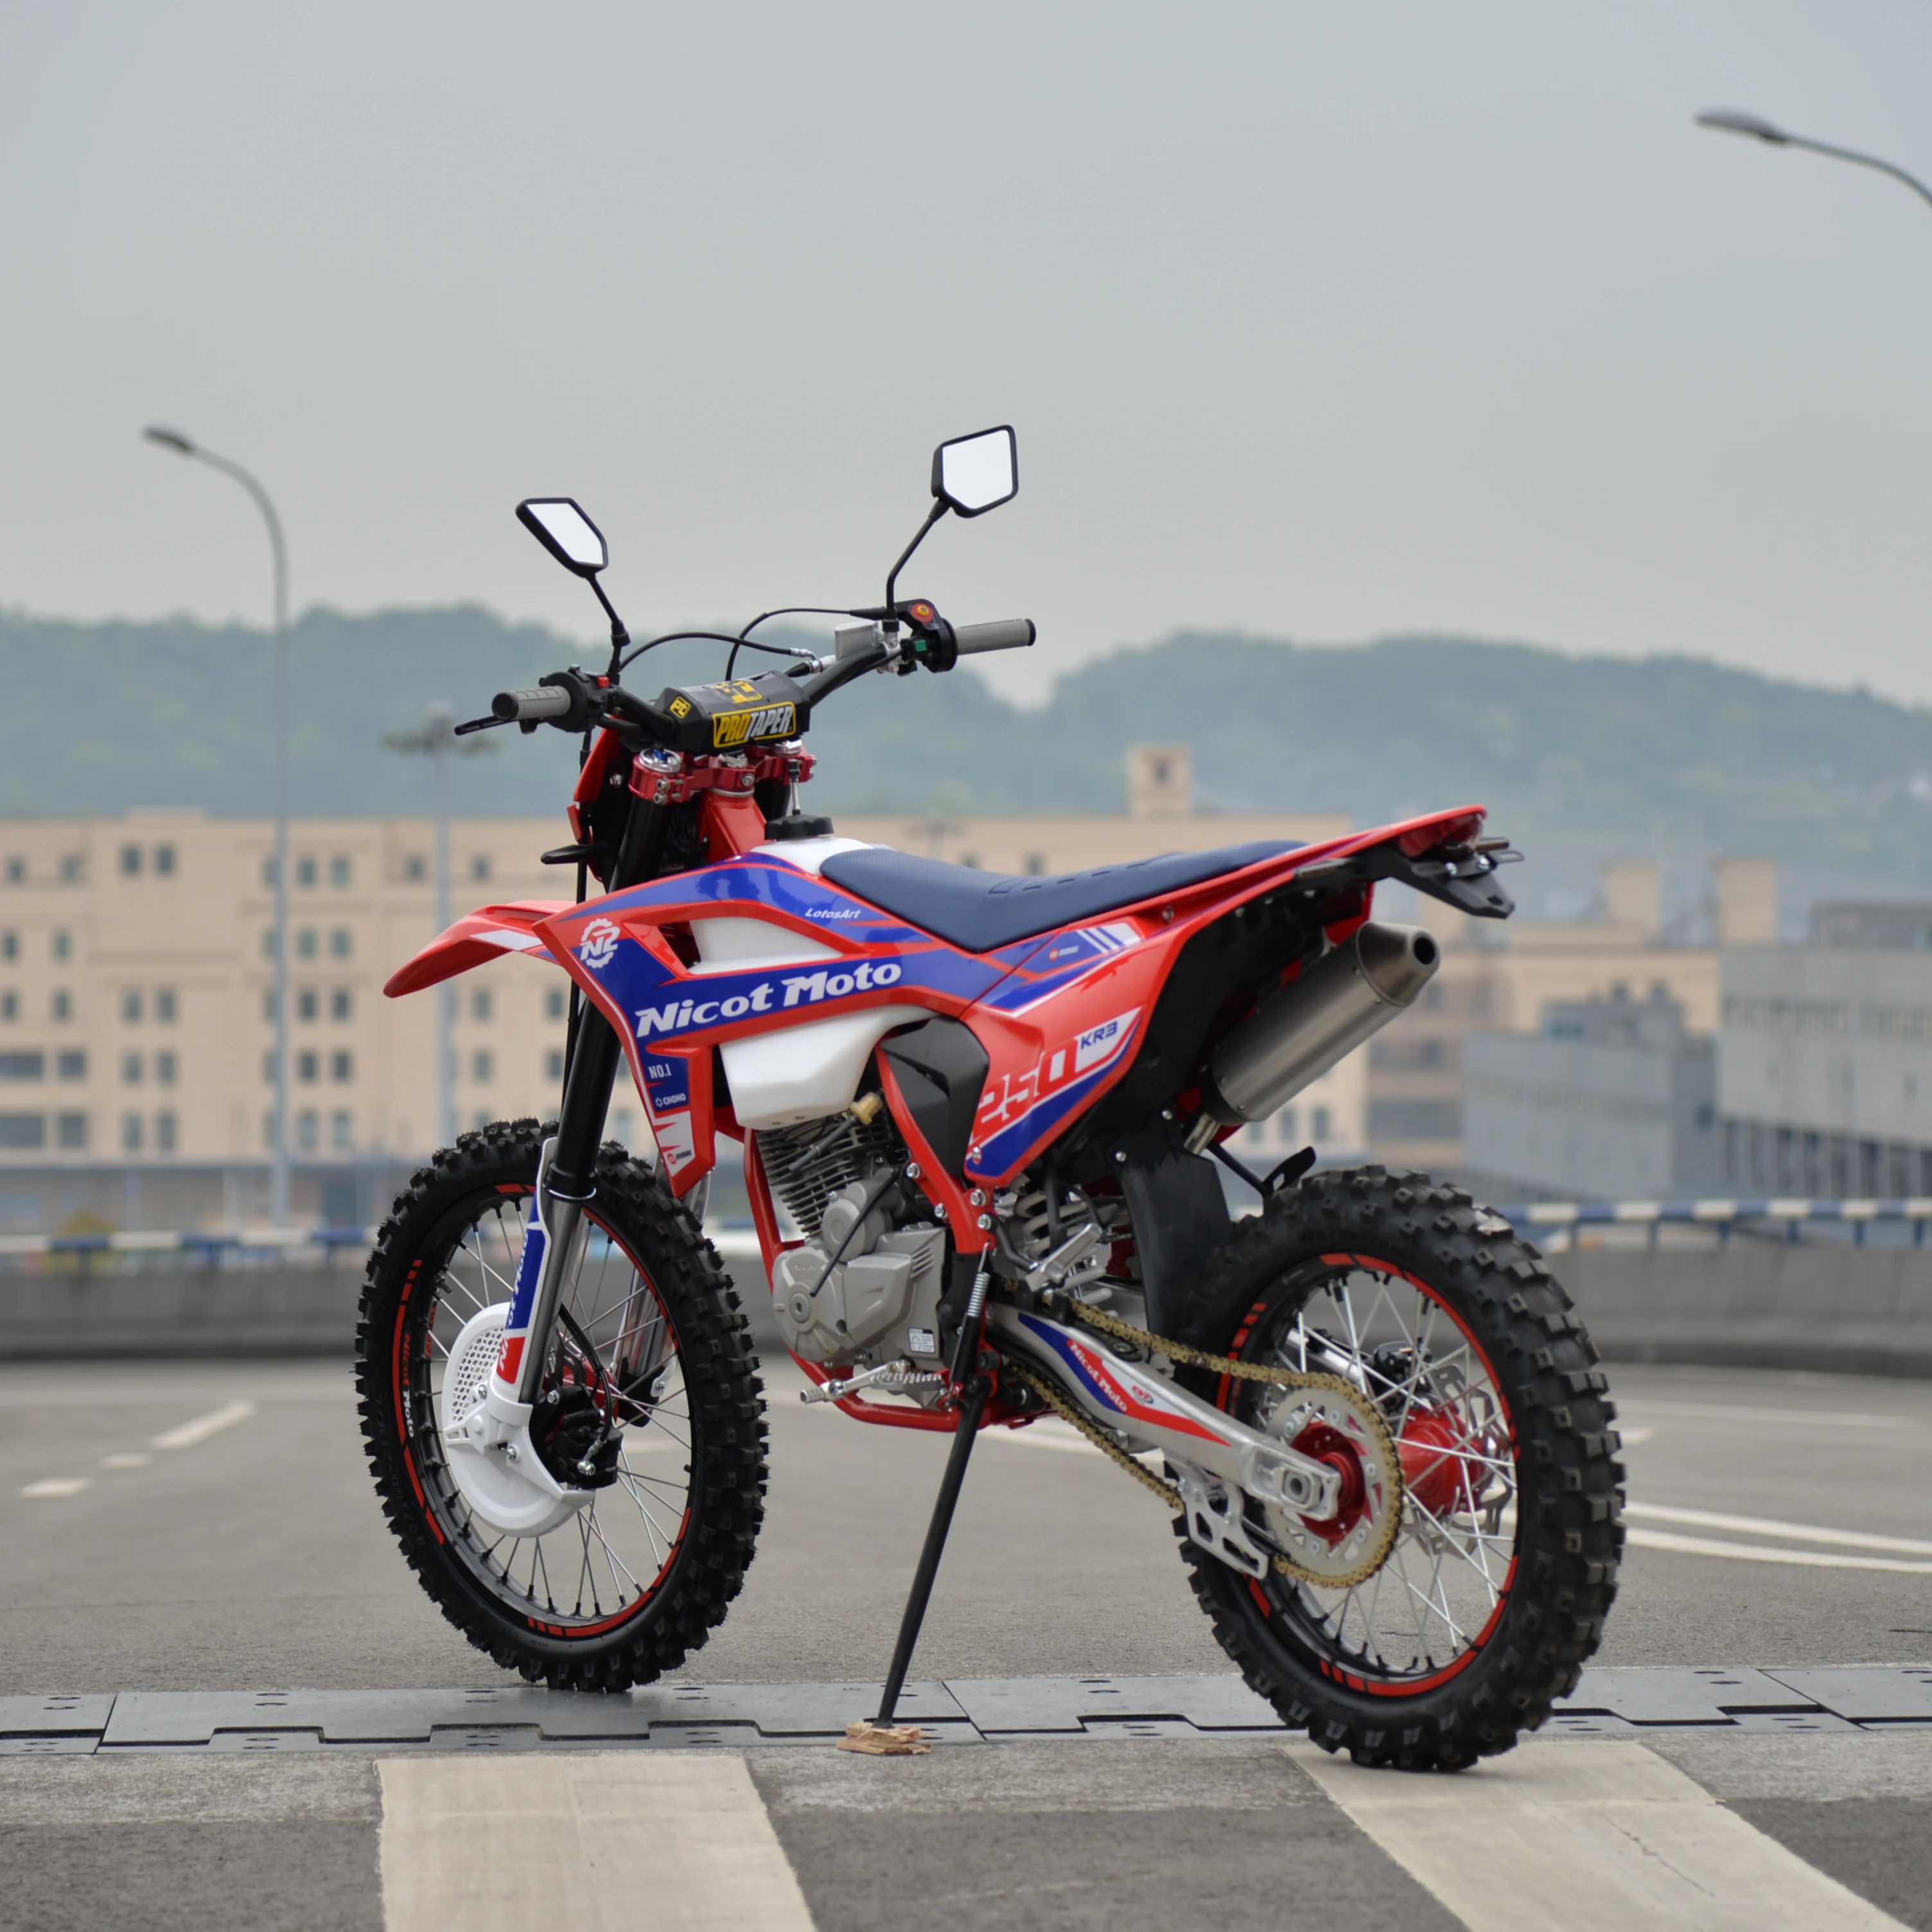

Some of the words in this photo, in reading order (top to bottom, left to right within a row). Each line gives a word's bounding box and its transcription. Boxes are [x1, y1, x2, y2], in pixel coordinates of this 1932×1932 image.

[717, 706, 793, 742] PROTAPER
[805, 908, 861, 918] LotosArt
[635, 983, 773, 1037] Nicot
[781, 963, 901, 1006] Moto
[1080, 1021, 1118, 1049] KR3
[973, 1037, 1077, 1134] 250
[1070, 1342, 1100, 1380] Nicot
[1098, 1376, 1127, 1411] Moto
[403, 1390, 414, 1438] Moto
